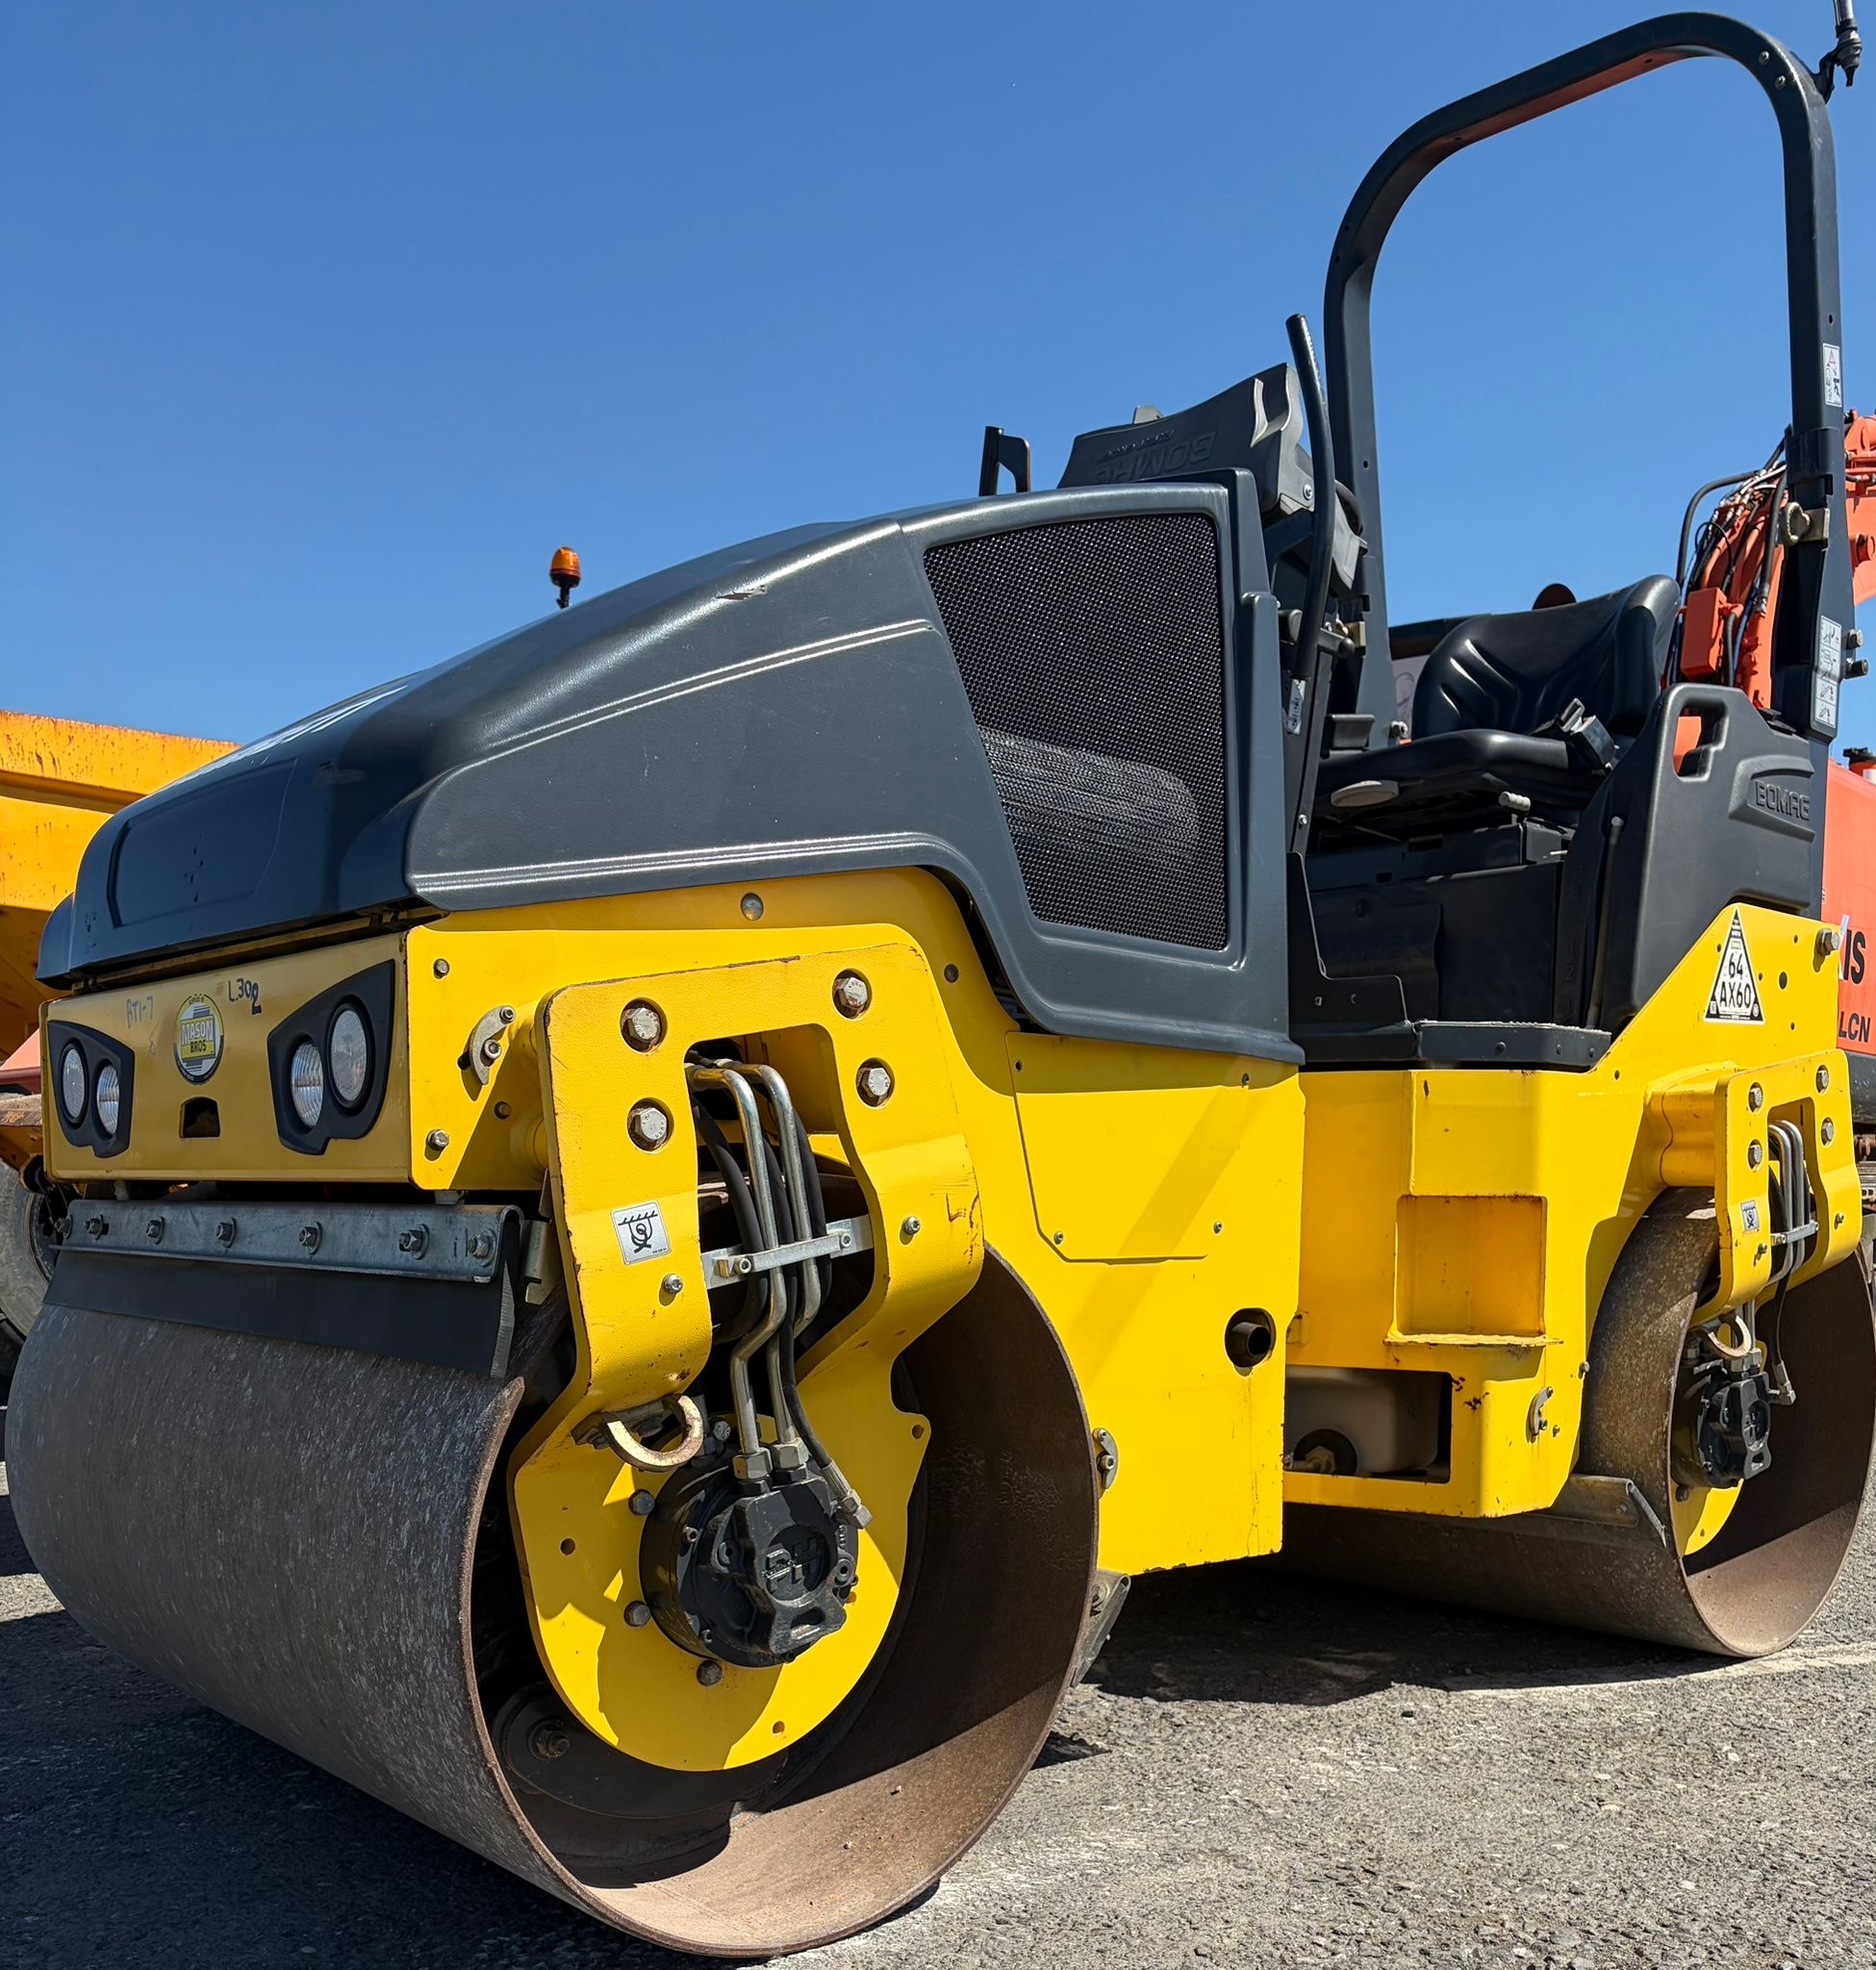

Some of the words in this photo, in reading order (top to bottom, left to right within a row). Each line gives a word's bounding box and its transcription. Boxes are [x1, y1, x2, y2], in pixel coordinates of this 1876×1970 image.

[1755, 779, 1810, 821] BOMAG
[1729, 951, 1744, 979] 64
[1719, 981, 1752, 1009] AX60
[181, 1021, 214, 1046] MASON
[1838, 1011, 1871, 1044] LCN
[190, 1040, 207, 1053] BROS
